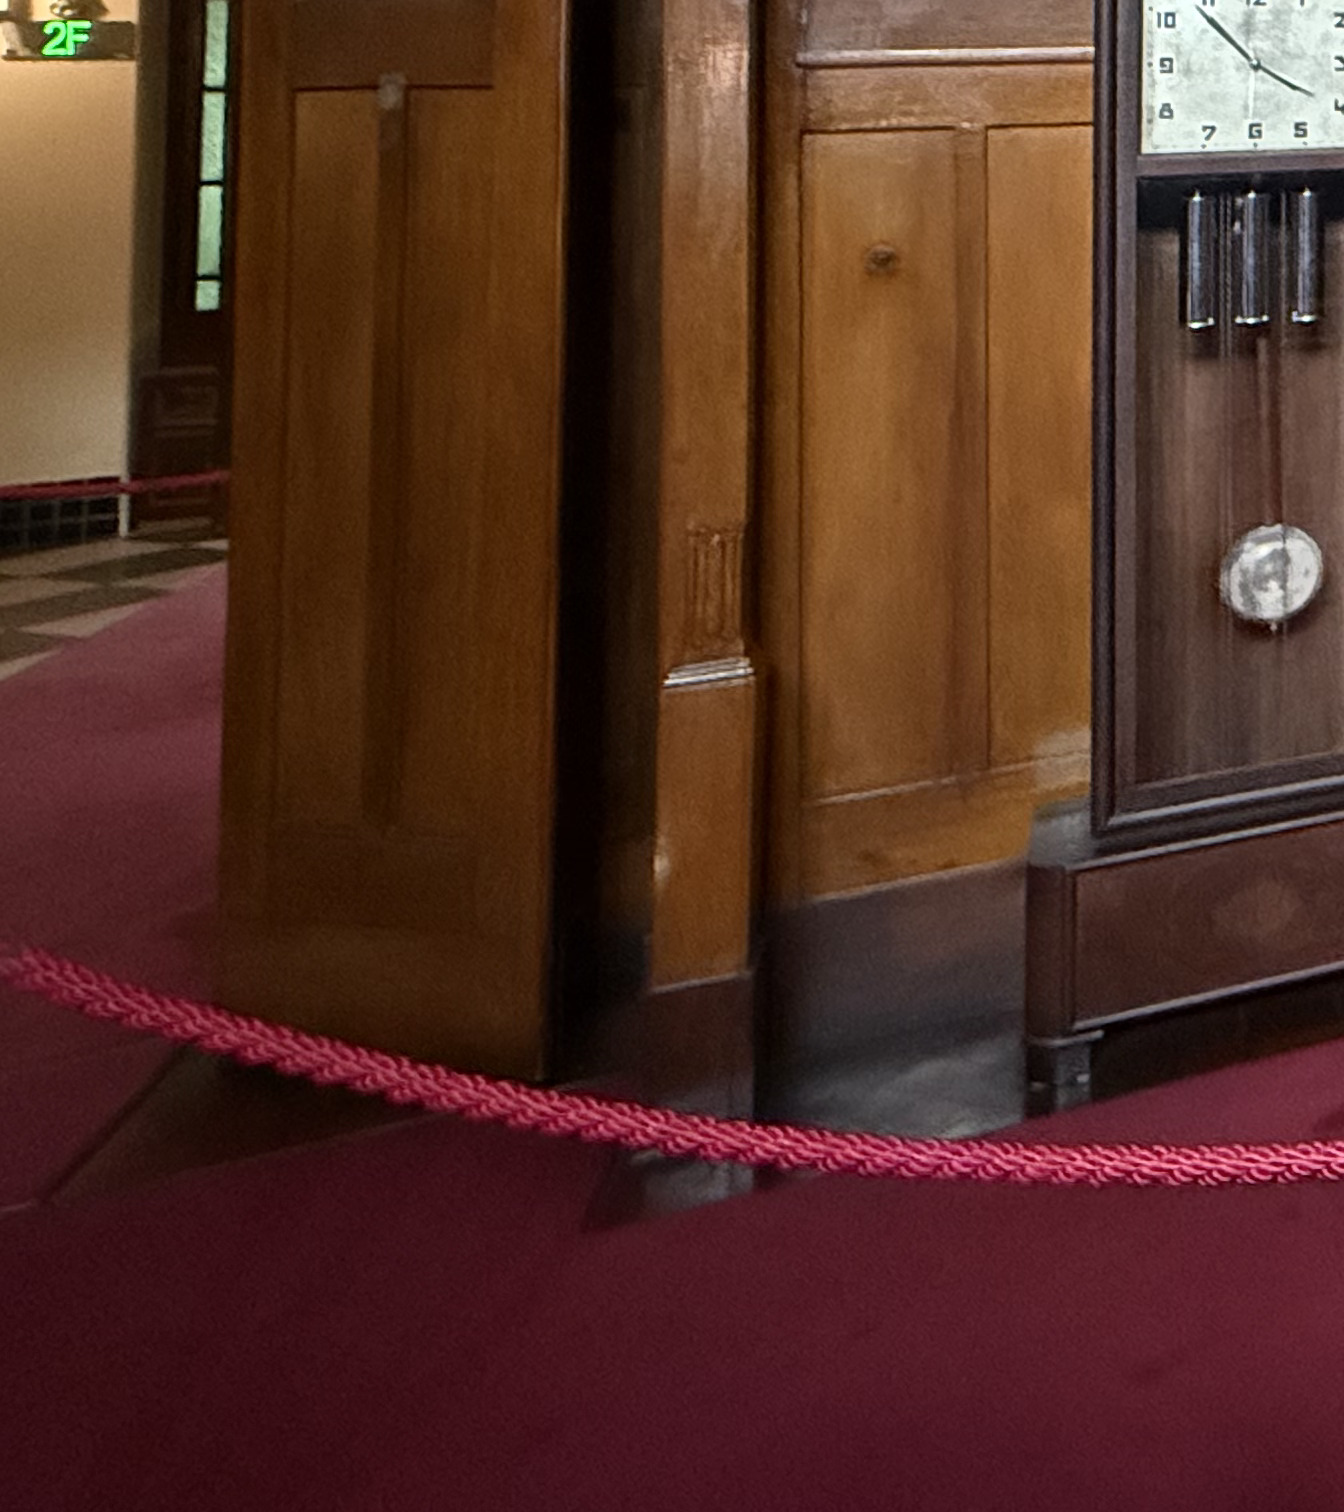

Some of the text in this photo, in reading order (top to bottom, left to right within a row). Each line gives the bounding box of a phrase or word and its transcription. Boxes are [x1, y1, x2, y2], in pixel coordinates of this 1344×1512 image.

[1157, 12, 1176, 29] 10
[41, 19, 92, 56] 2F
[1159, 57, 1174, 73] 9
[1159, 103, 1174, 119] 8
[1202, 125, 1217, 141] 7
[1294, 122, 1308, 138] 5
